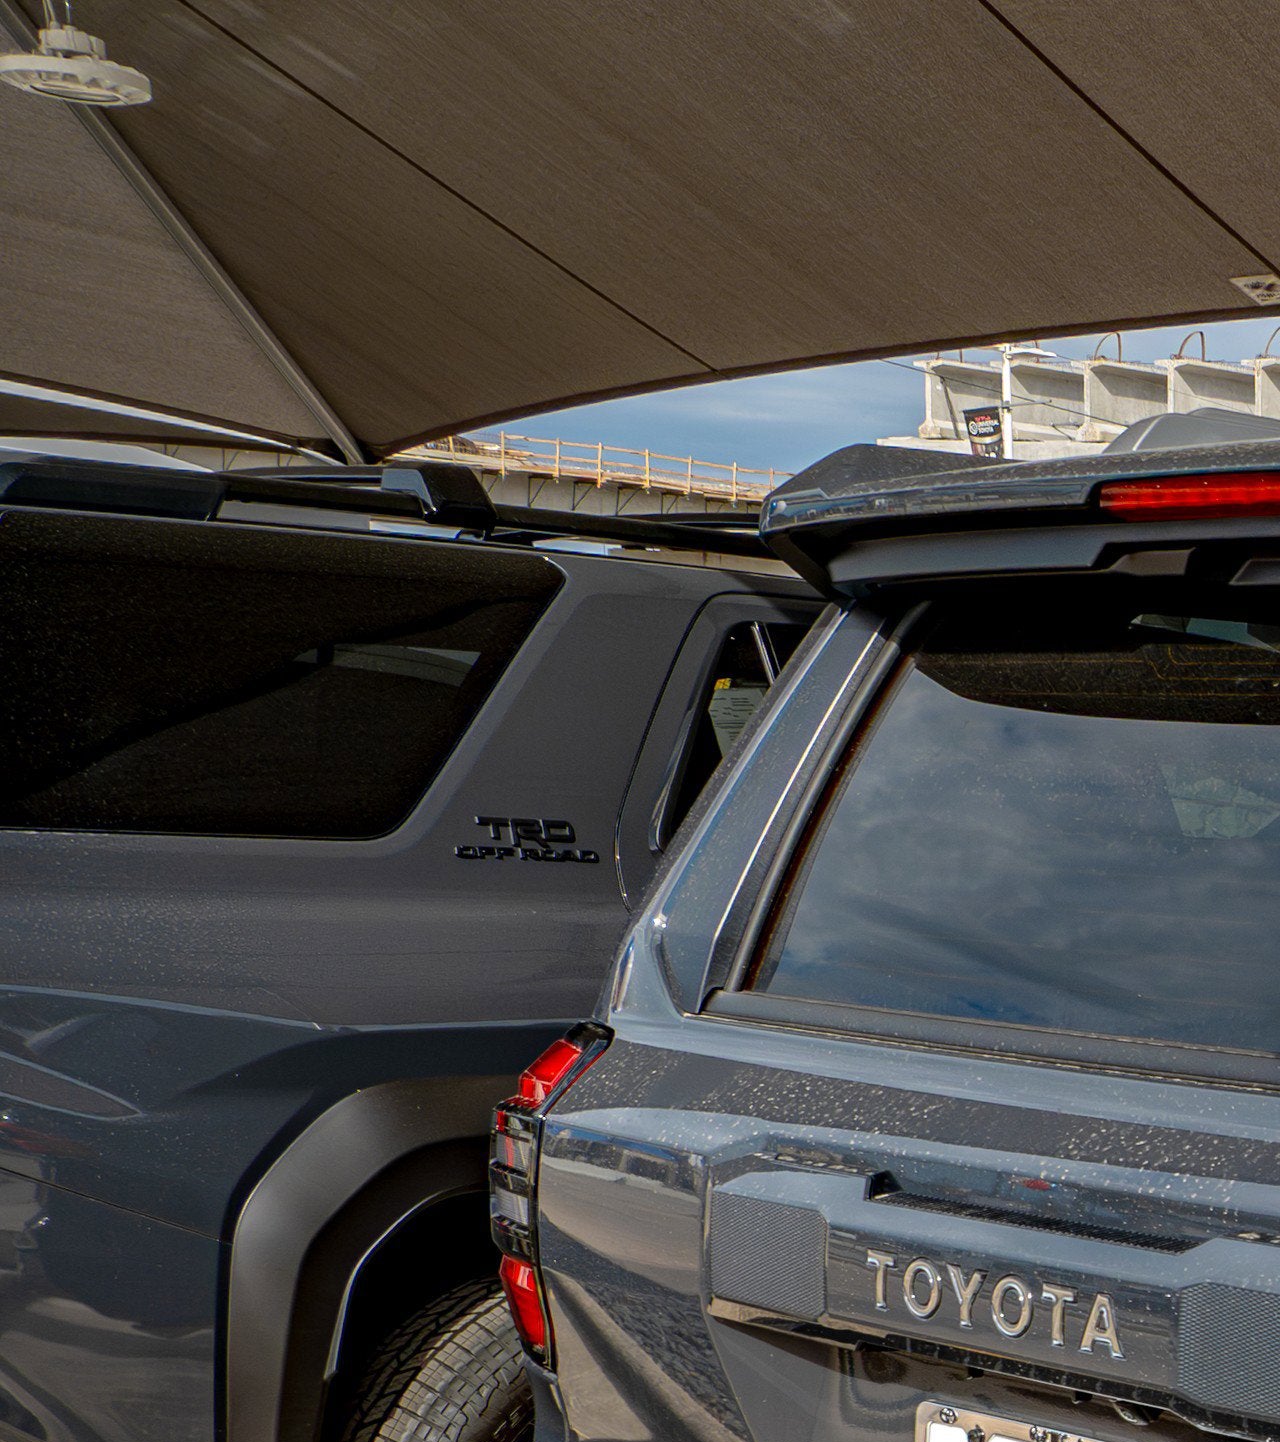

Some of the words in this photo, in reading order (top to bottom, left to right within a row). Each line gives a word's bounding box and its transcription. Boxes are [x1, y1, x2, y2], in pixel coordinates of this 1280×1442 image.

[475, 816, 576, 848] TRD
[454, 845, 515, 860] OFF
[519, 847, 600, 863] ROAD
[865, 1249, 1126, 1361] TOYOTA
